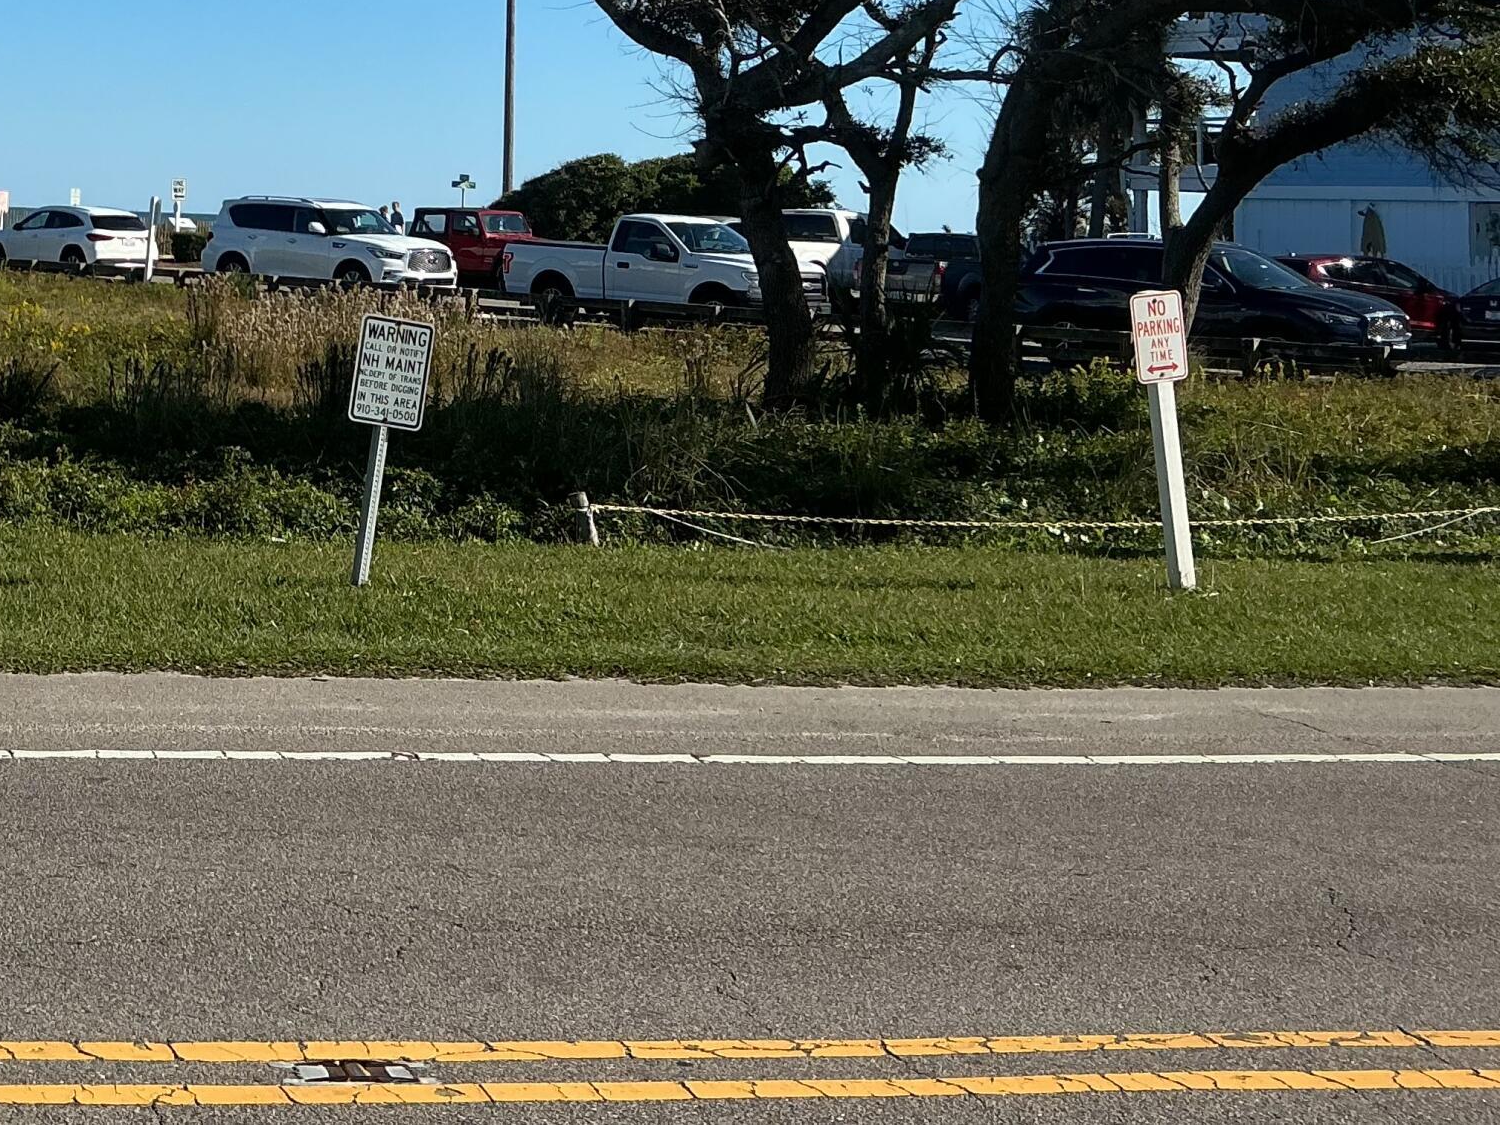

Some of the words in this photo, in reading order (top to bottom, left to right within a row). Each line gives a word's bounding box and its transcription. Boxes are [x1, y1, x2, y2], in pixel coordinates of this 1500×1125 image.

[1147, 300, 1165, 317] NO
[368, 323, 428, 347] WARNING
[1137, 317, 1179, 337] PARKING
[366, 341, 382, 352] CALL
[387, 345, 396, 354] OR
[400, 347, 424, 358] NOTIFY
[1151, 337, 1169, 349] ANY
[363, 352, 379, 367] NH
[385, 357, 423, 375] MAINT
[1150, 350, 1173, 362] TIME
[360, 379, 388, 390] BEFORE
[391, 383, 419, 395] DIGGING
[389, 373, 397, 381] OF
[401, 375, 421, 384] TRANS
[357, 391, 366, 401] IN
[371, 393, 389, 405] THIS
[393, 397, 417, 410] AREA
[356, 403, 416, 422] 910-341-0500
